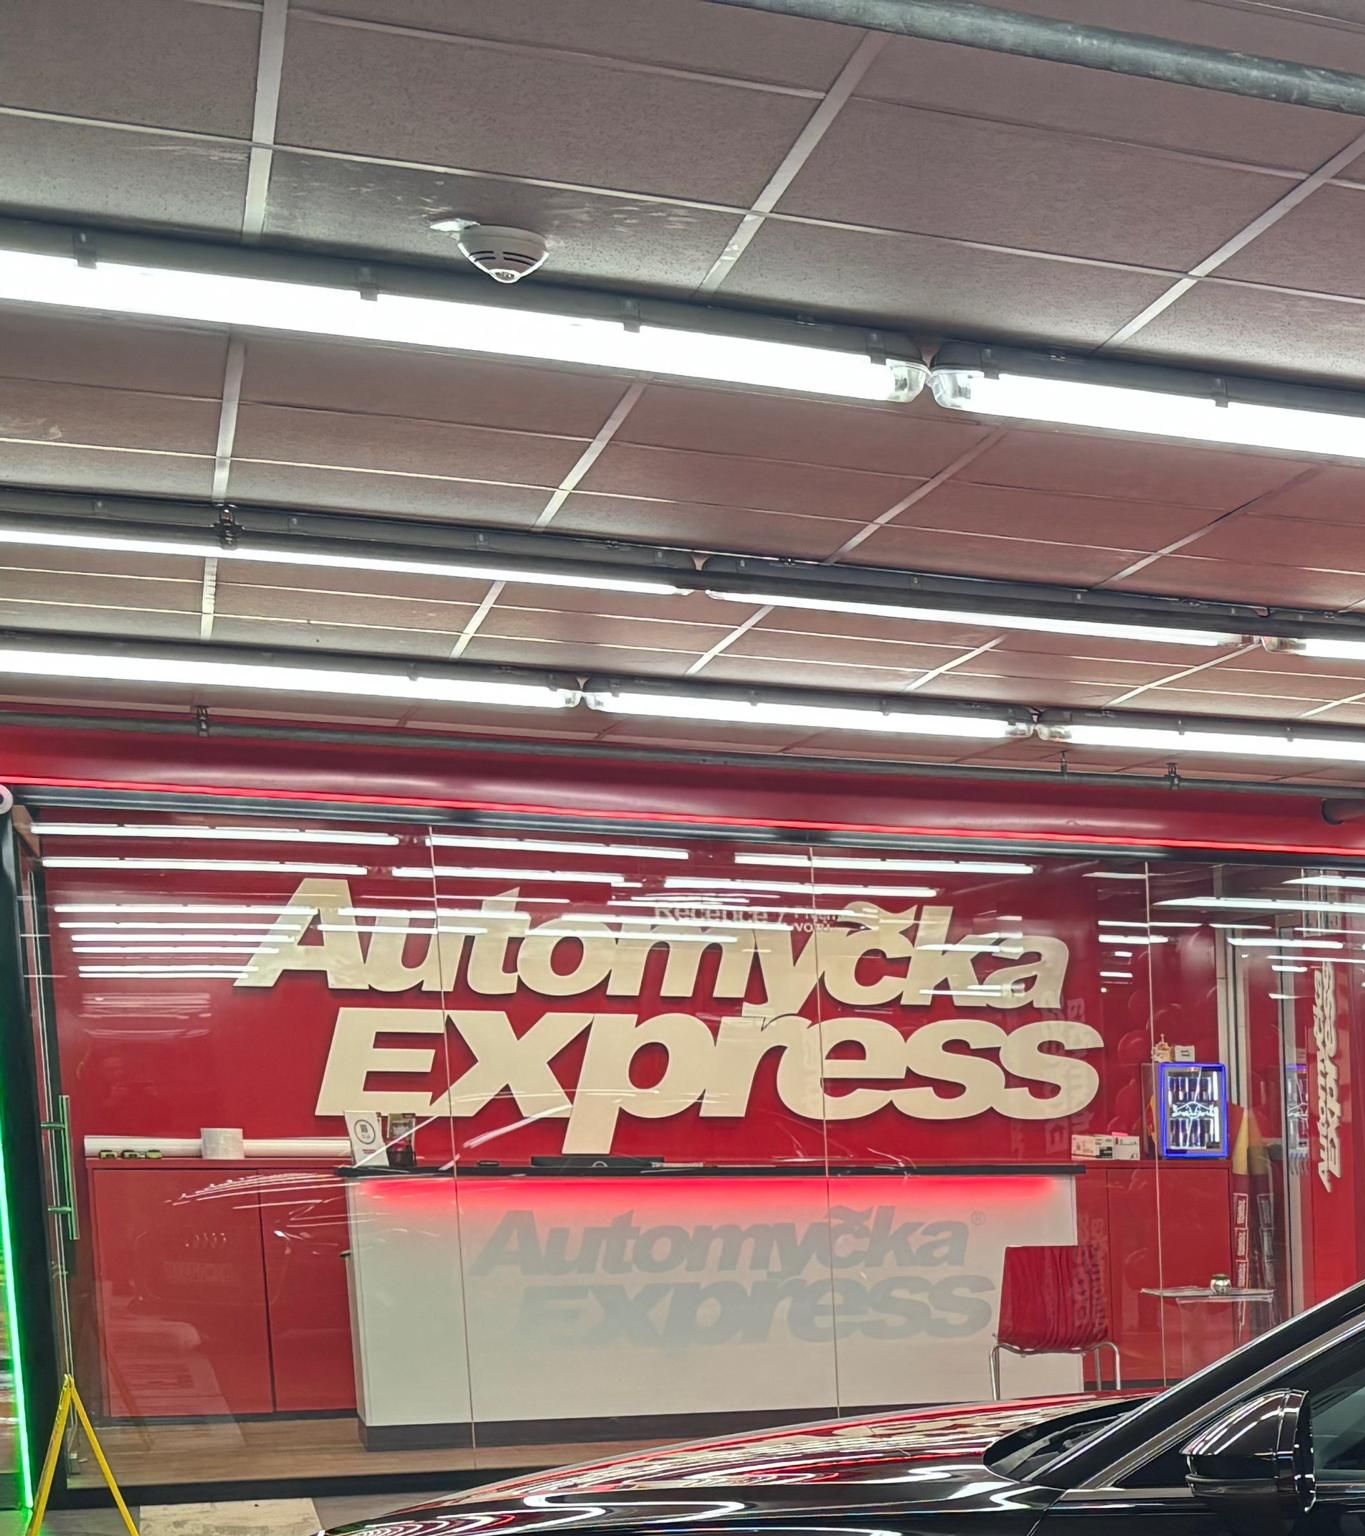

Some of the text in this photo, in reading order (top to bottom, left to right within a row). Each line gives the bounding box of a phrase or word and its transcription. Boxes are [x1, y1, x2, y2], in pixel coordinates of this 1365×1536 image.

[233, 878, 1069, 1018] Automyčka
[315, 1006, 1104, 1154] Express
[517, 1275, 996, 1360] Express
